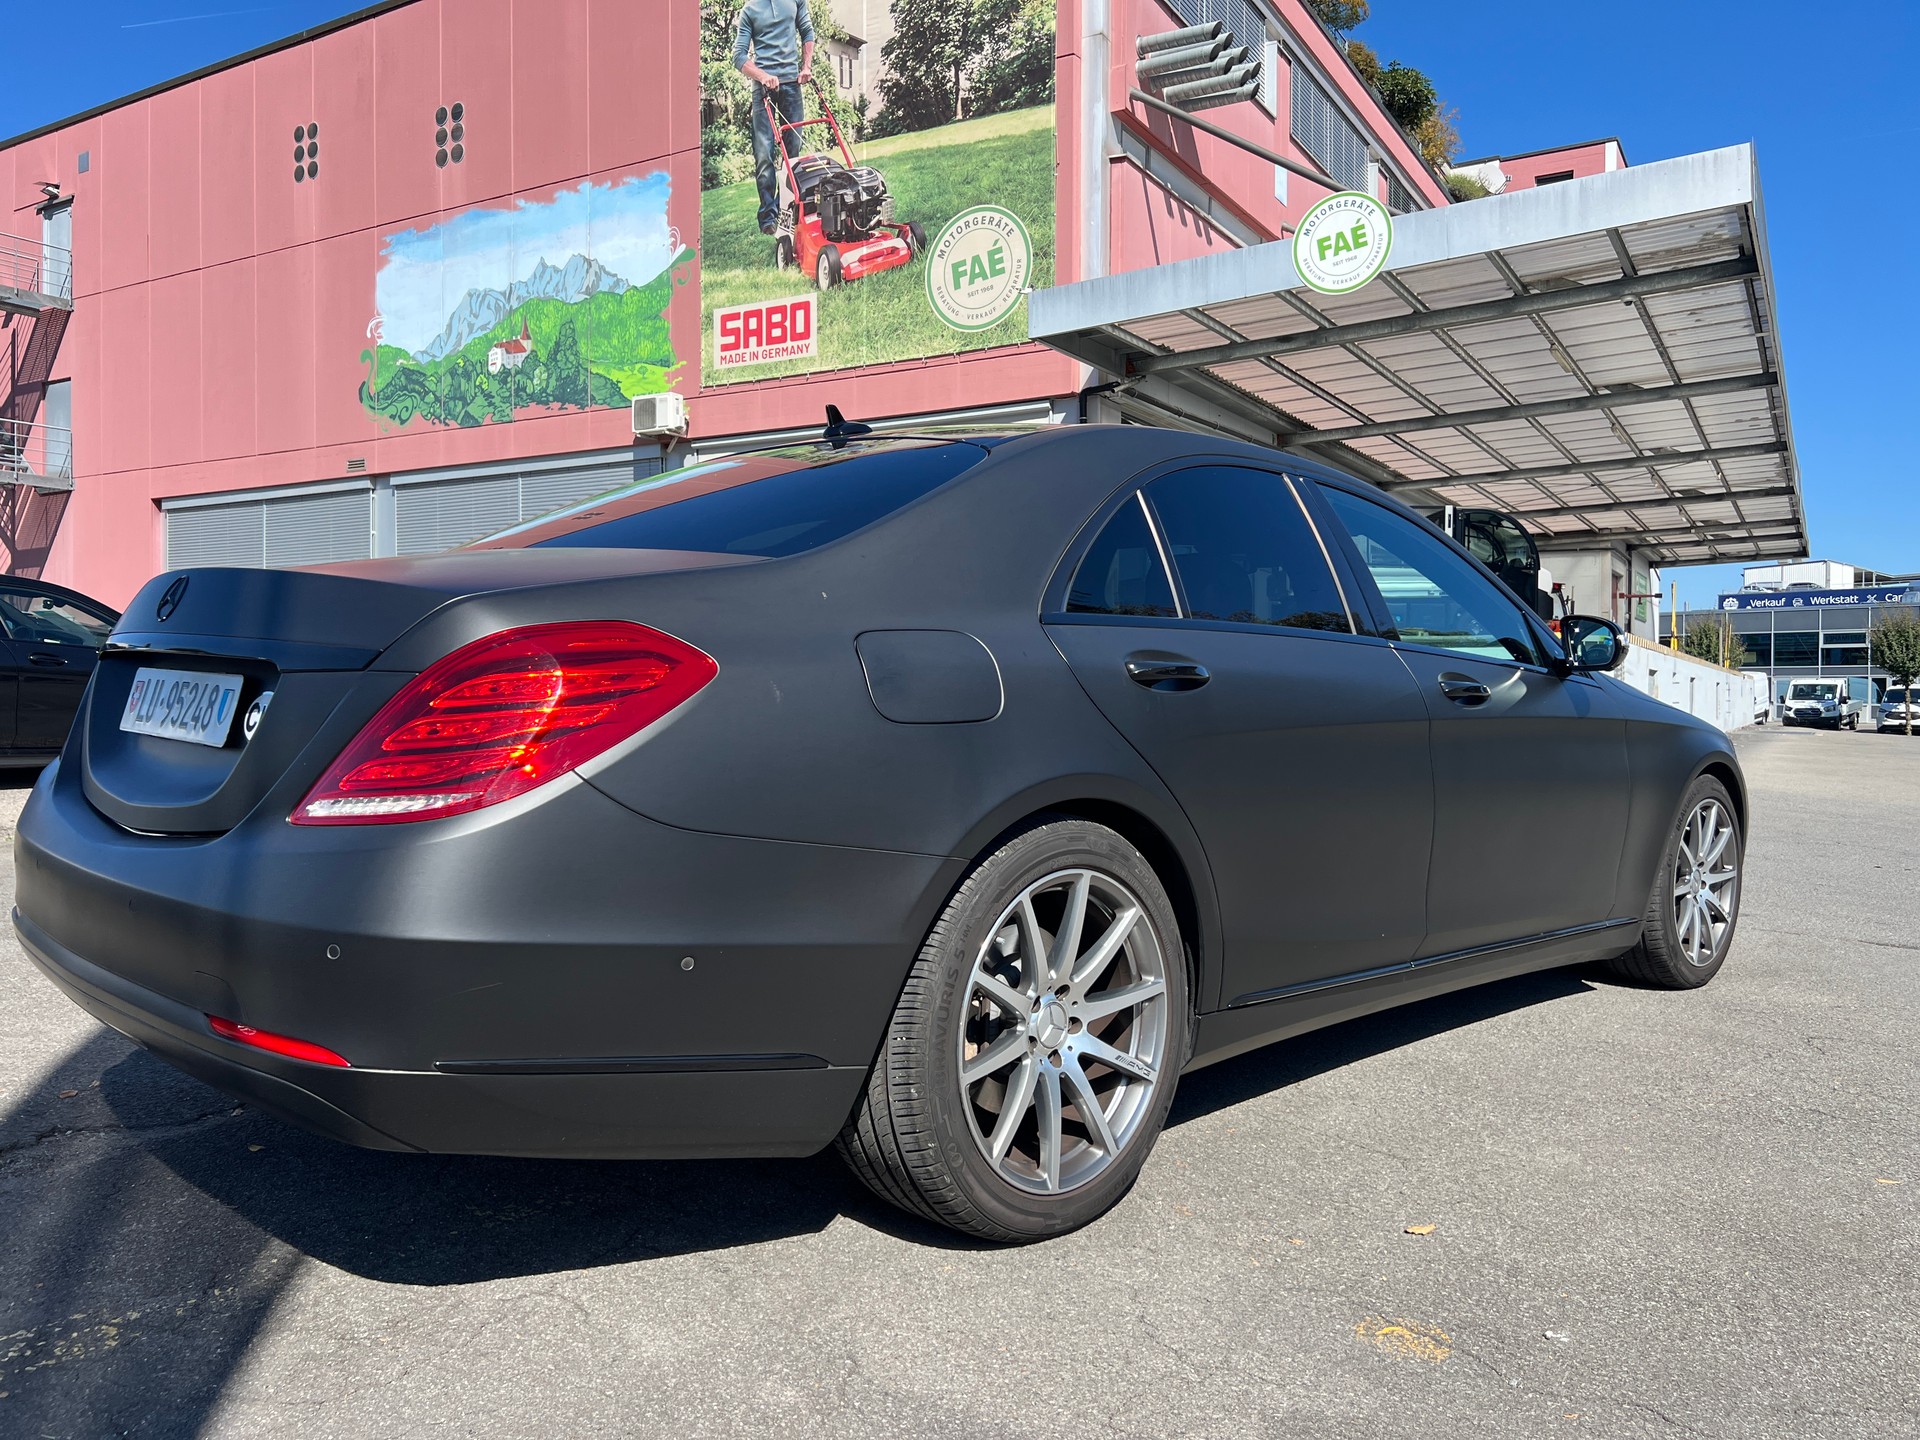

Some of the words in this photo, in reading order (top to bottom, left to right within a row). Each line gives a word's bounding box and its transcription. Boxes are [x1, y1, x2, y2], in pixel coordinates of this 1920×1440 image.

[1303, 200, 1375, 237] MOTORGERÄTE
[938, 216, 1015, 259] MOTORGERÄTE
[1317, 217, 1368, 261] FAÉ
[951, 238, 1006, 291] FAÉ
[1303, 258, 1325, 283] BERATUNG
[1332, 273, 1360, 285] VERKAUF
[1332, 259, 1344, 267] SEIT
[936, 286, 960, 317] BERATUNG
[966, 306, 997, 320] VERKAUF
[1003, 258, 1022, 303] REPARATUR
[967, 289, 980, 298] SEIT
[981, 284, 994, 294] 1968
[720, 300, 810, 352] SABO
[720, 352, 747, 365] MADE
[749, 351, 759, 361] IN
[762, 343, 811, 359] GERMANY
[1750, 597, 1786, 608] Verkauf
[1810, 595, 1859, 605] Werkstatt
[959, 923, 972, 944] HM
[953, 947, 966, 963] 5
[934, 964, 959, 1090] BRAVURIS
